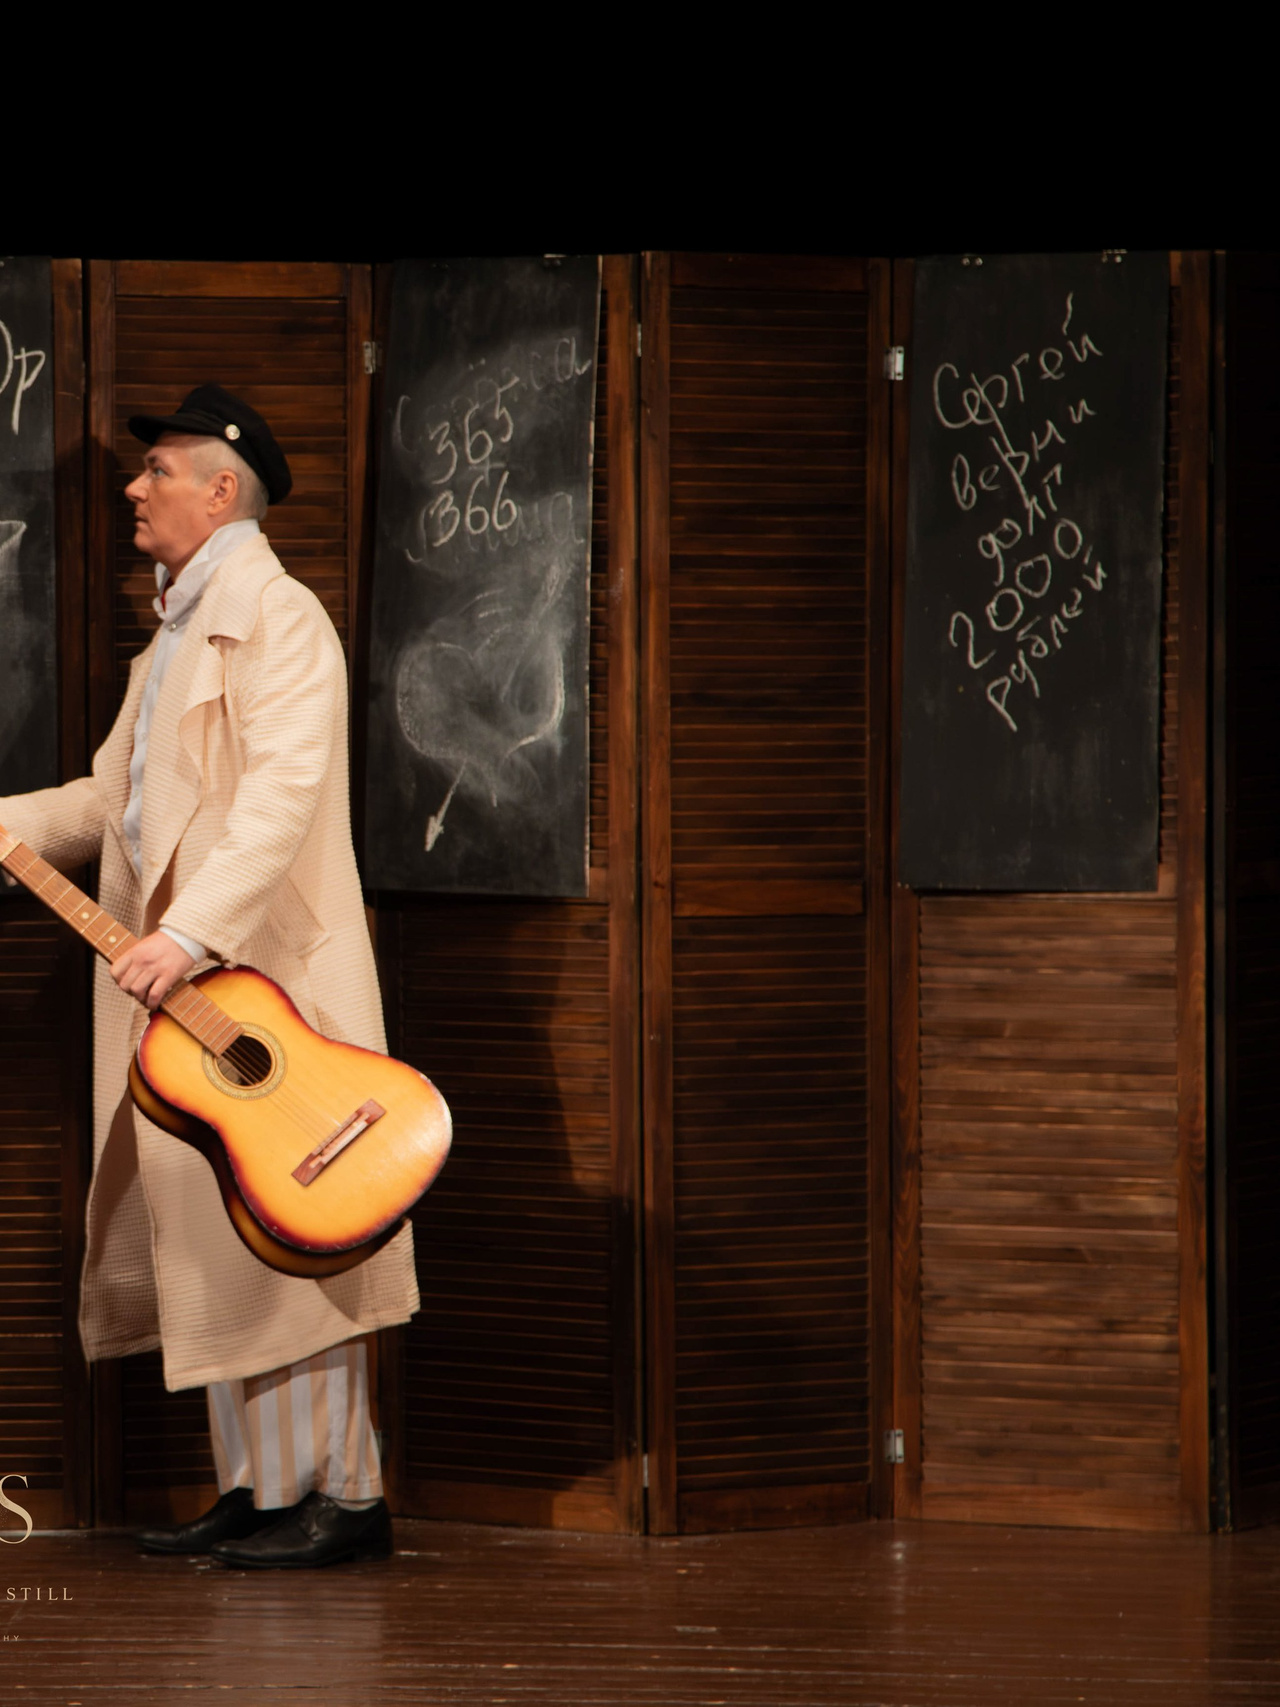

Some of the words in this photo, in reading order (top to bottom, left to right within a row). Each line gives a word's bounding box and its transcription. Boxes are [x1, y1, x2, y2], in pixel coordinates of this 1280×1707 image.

[428, 376, 519, 486] 365
[428, 470, 518, 548] 366
[948, 517, 1083, 669] 2000
